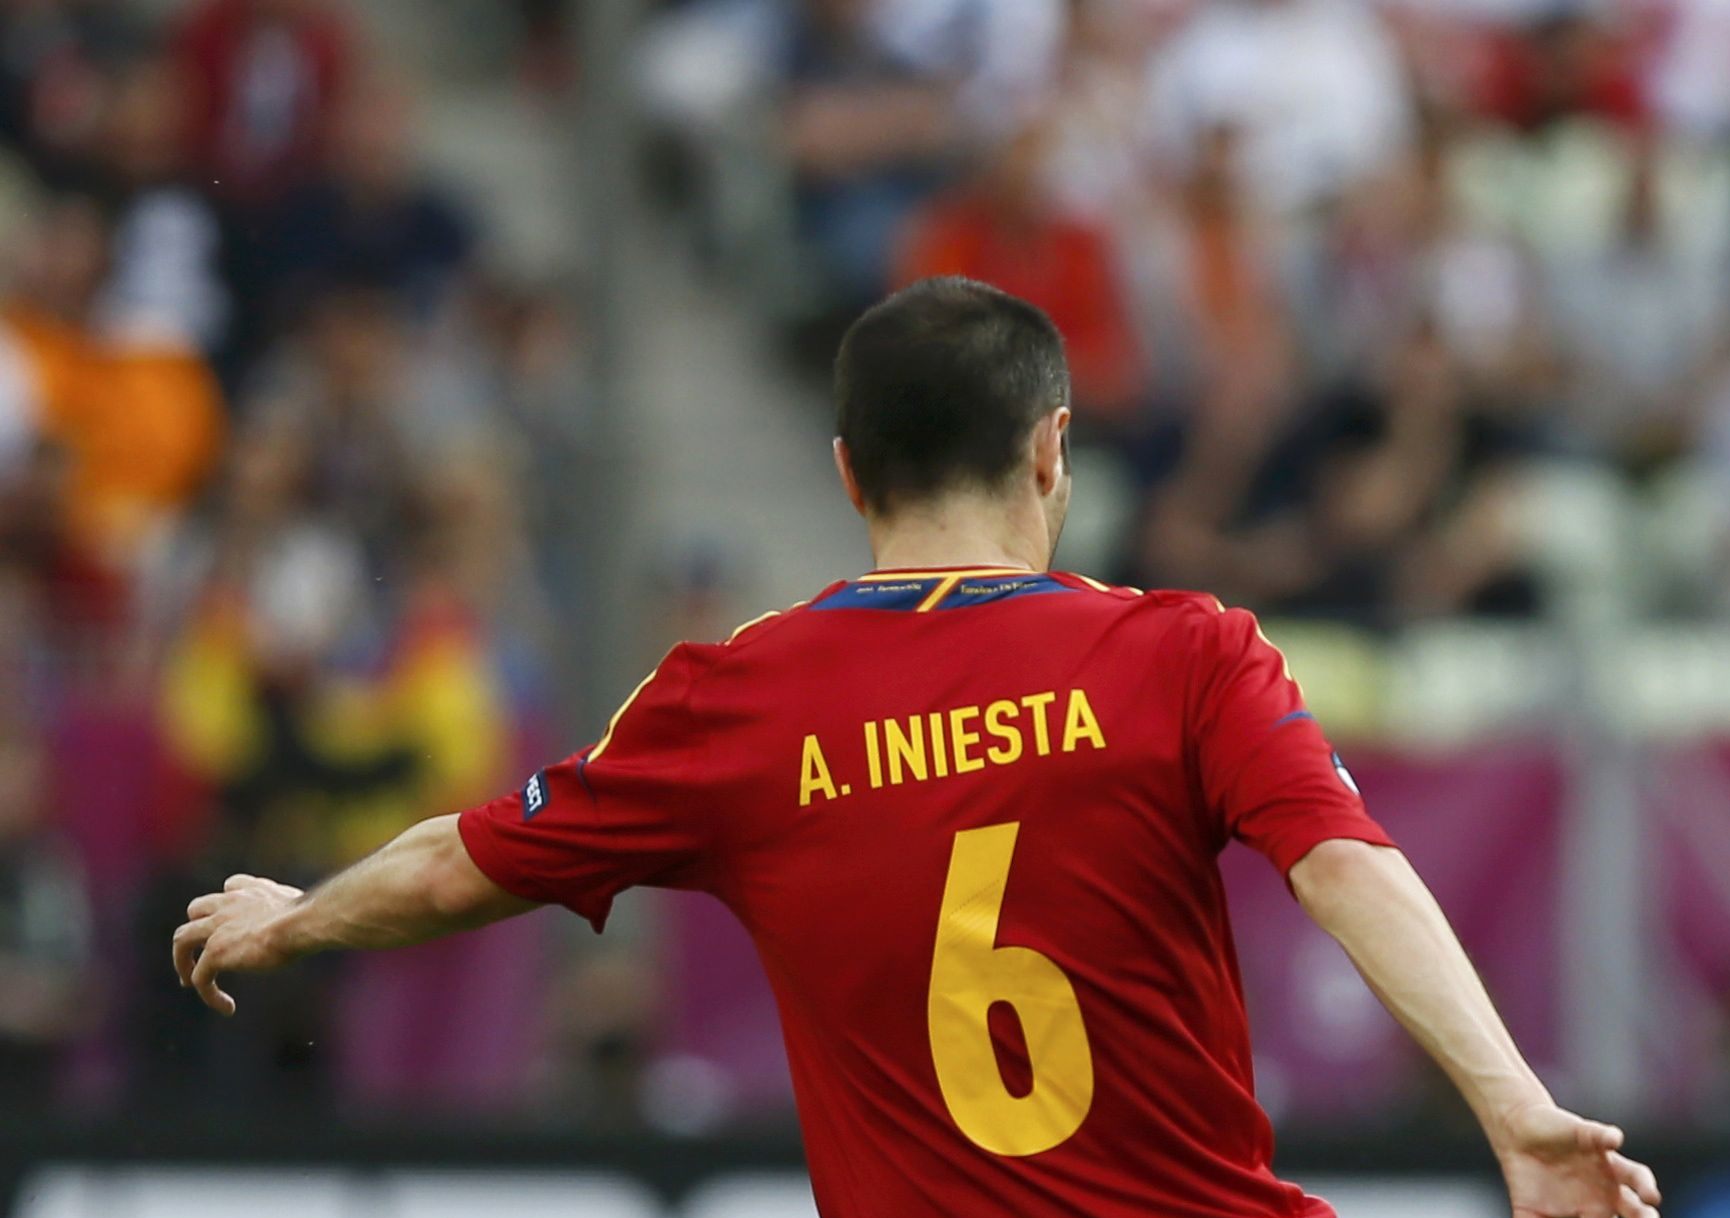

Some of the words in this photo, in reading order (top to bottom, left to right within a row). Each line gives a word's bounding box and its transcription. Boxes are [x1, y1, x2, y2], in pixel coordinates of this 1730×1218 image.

[799, 733, 851, 806] A.
[863, 688, 1106, 789] INIESTA
[927, 820, 1095, 1157] 6
